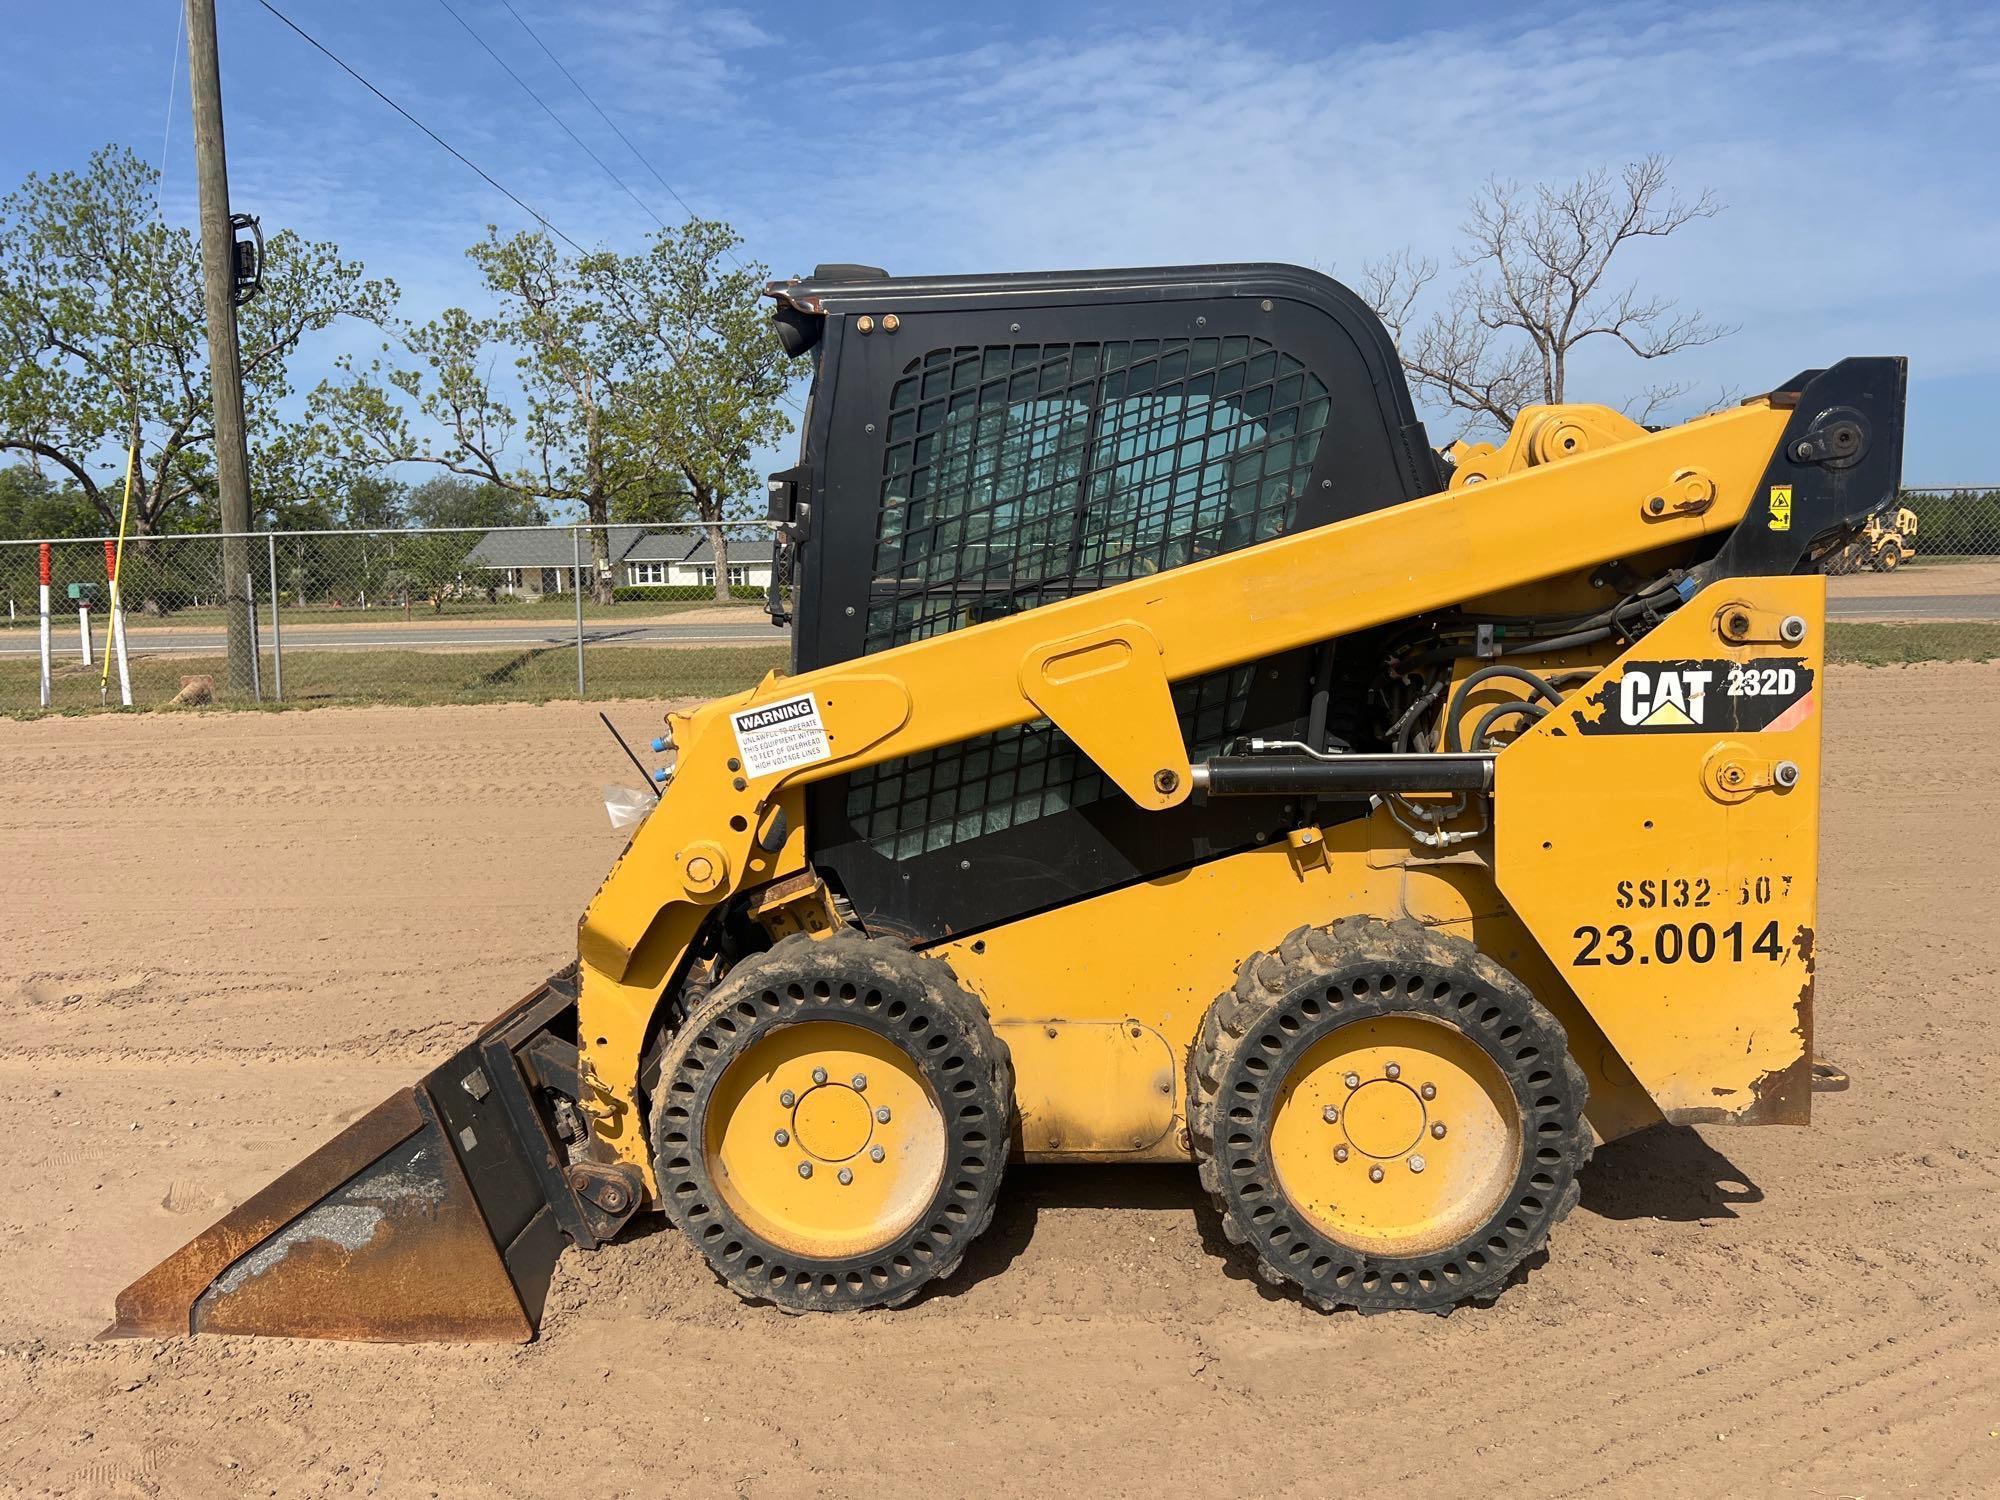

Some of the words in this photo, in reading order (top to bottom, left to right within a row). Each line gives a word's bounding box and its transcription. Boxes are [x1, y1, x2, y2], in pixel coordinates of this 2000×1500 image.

[1620, 671, 1713, 726] CAT
[1727, 668, 1796, 696] 232D
[739, 702, 811, 730] WARNING
[742, 731, 778, 745] UNLAWFUL
[788, 719, 817, 732] OPERATE
[744, 743, 759, 754] THIS
[760, 734, 797, 751] EQUIPMENT
[798, 729, 822, 740] WITHIN
[750, 753, 758, 763] 10
[759, 749, 774, 760] FEET
[776, 746, 786, 756] OF
[787, 738, 821, 752] OVERHEAD
[755, 760, 771, 770] HIGH
[773, 752, 800, 766] VOLTAGE
[802, 746, 821, 758] LINES
[1572, 919, 1784, 967] 23.0014
